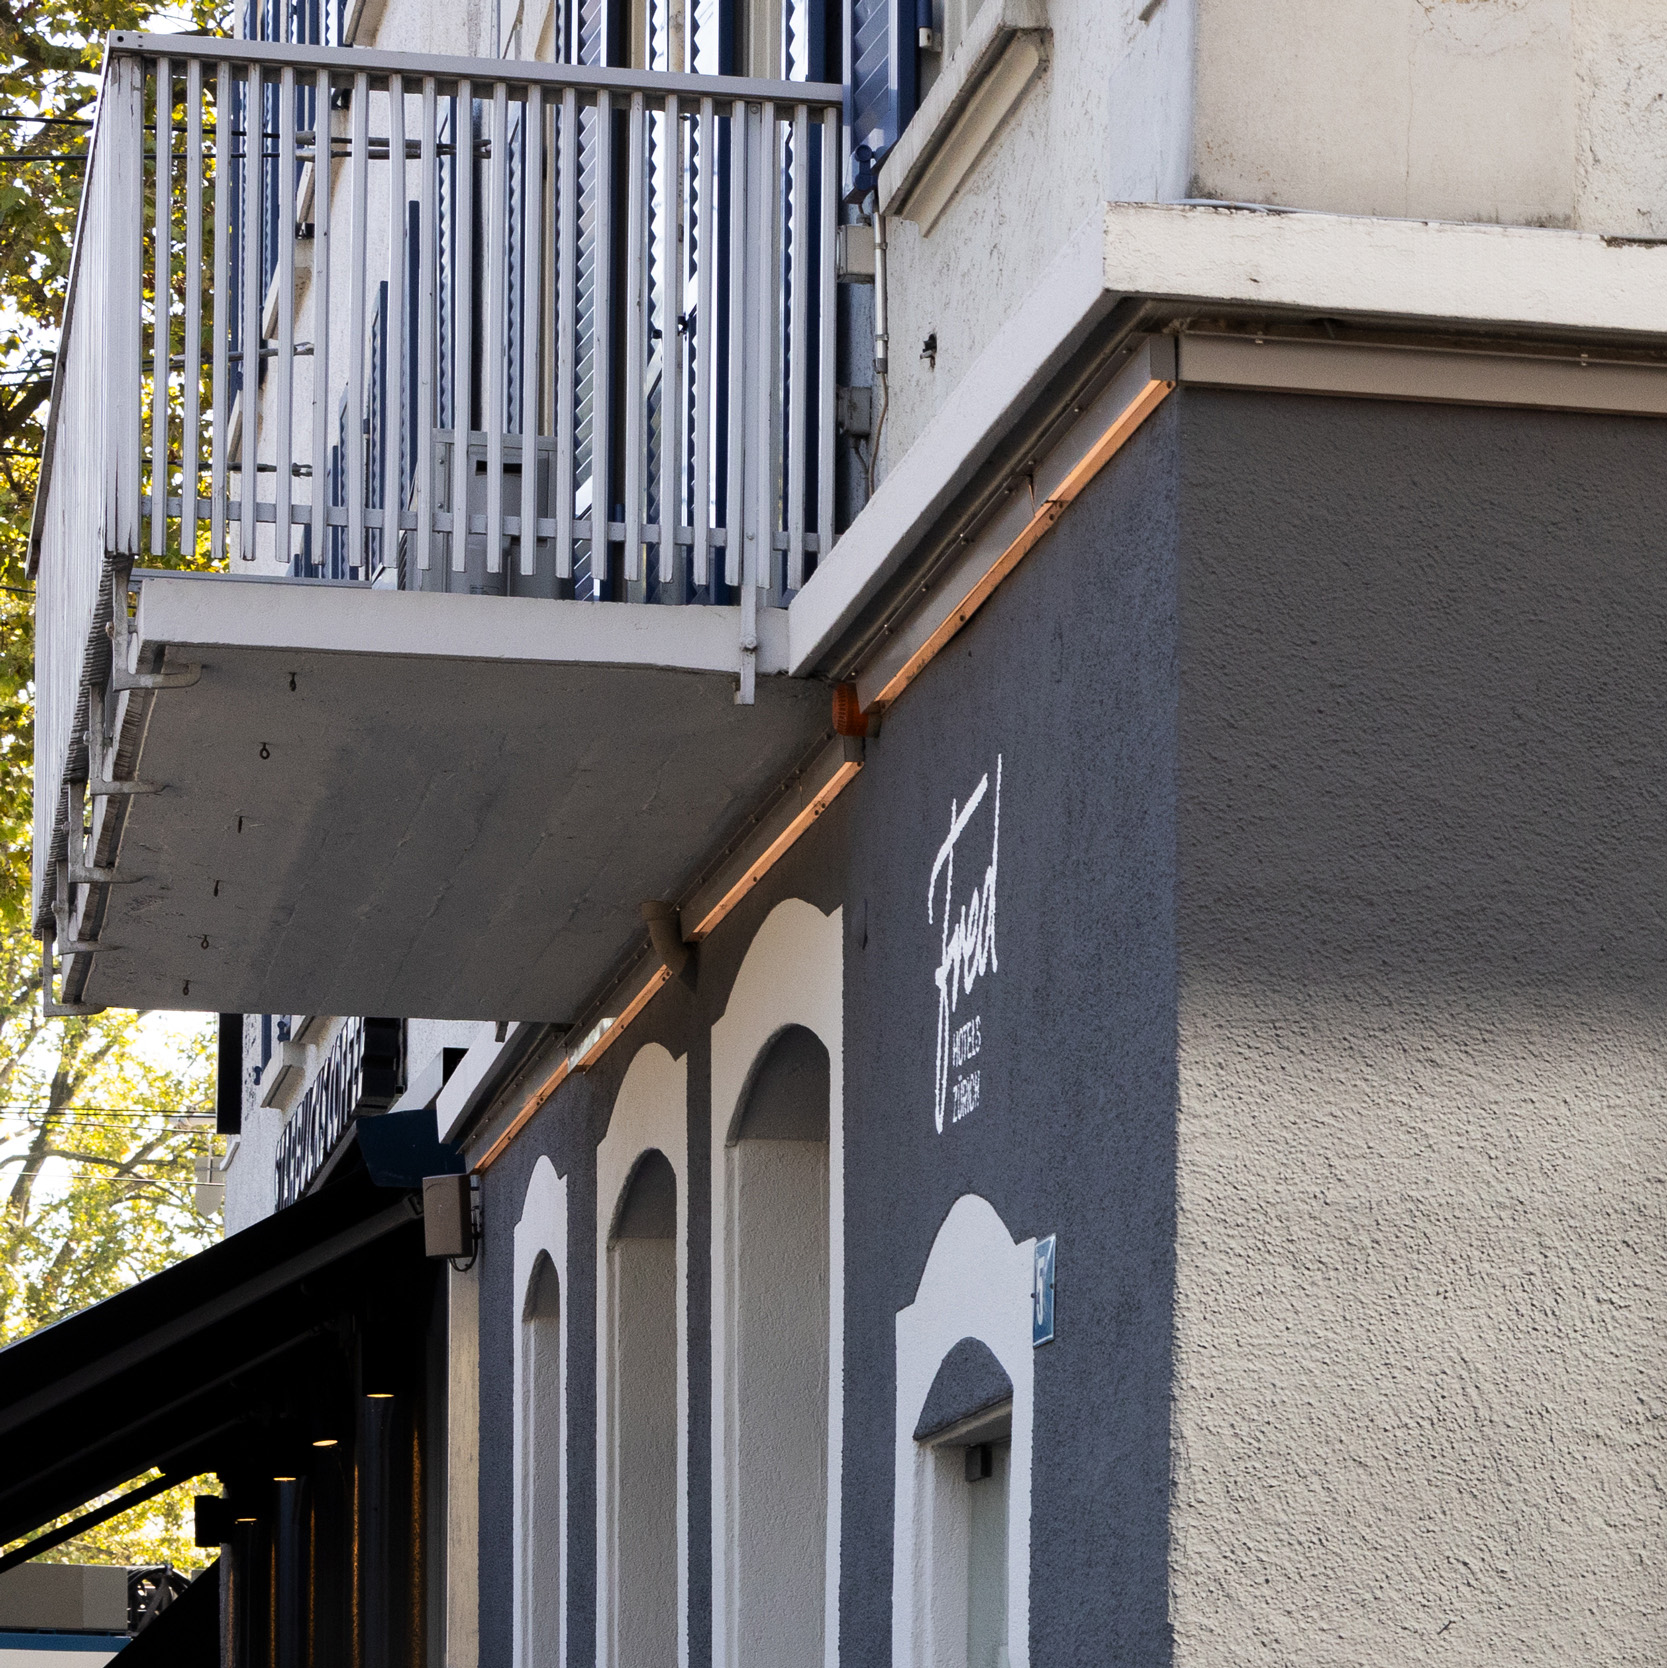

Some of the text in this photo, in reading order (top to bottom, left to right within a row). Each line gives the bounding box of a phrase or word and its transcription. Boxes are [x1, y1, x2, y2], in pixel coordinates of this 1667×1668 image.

[928, 753, 1003, 1135] Fred
[952, 1014, 982, 1068] HOTELS
[952, 1069, 981, 1124] ZÜRICH
[1036, 1256, 1045, 1326] 5
